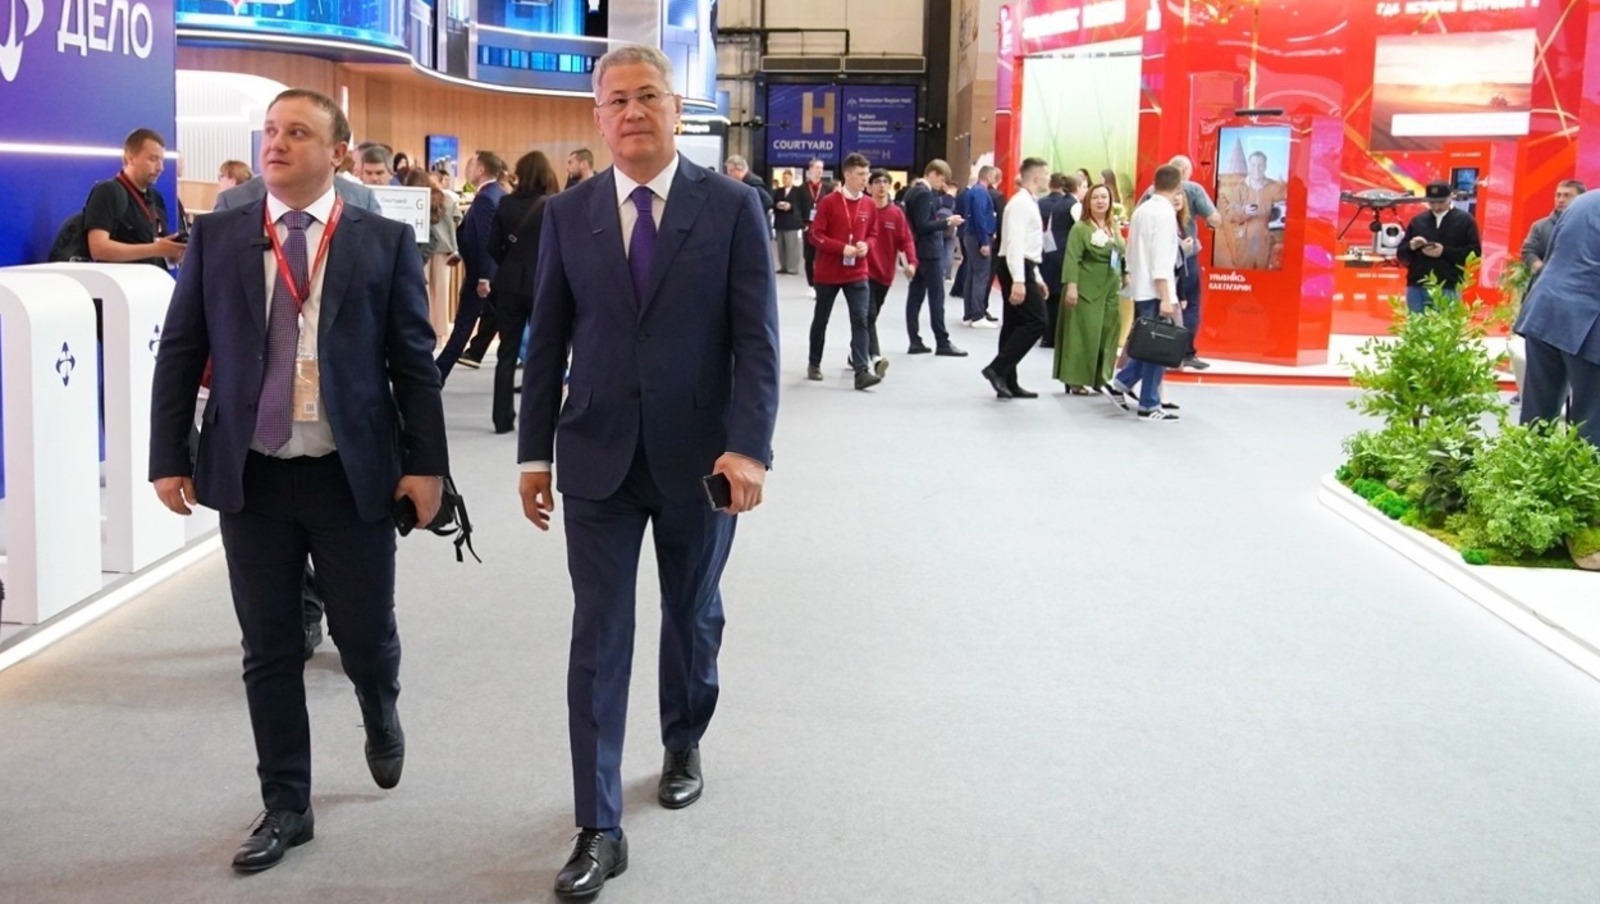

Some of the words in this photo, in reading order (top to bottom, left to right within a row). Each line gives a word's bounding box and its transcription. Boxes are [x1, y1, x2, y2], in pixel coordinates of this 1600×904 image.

[57, 0, 153, 59] ДЕЛО
[802, 92, 835, 134] H
[773, 140, 834, 150] COURTYARD
[415, 198, 424, 210] G
[415, 218, 424, 229] H
